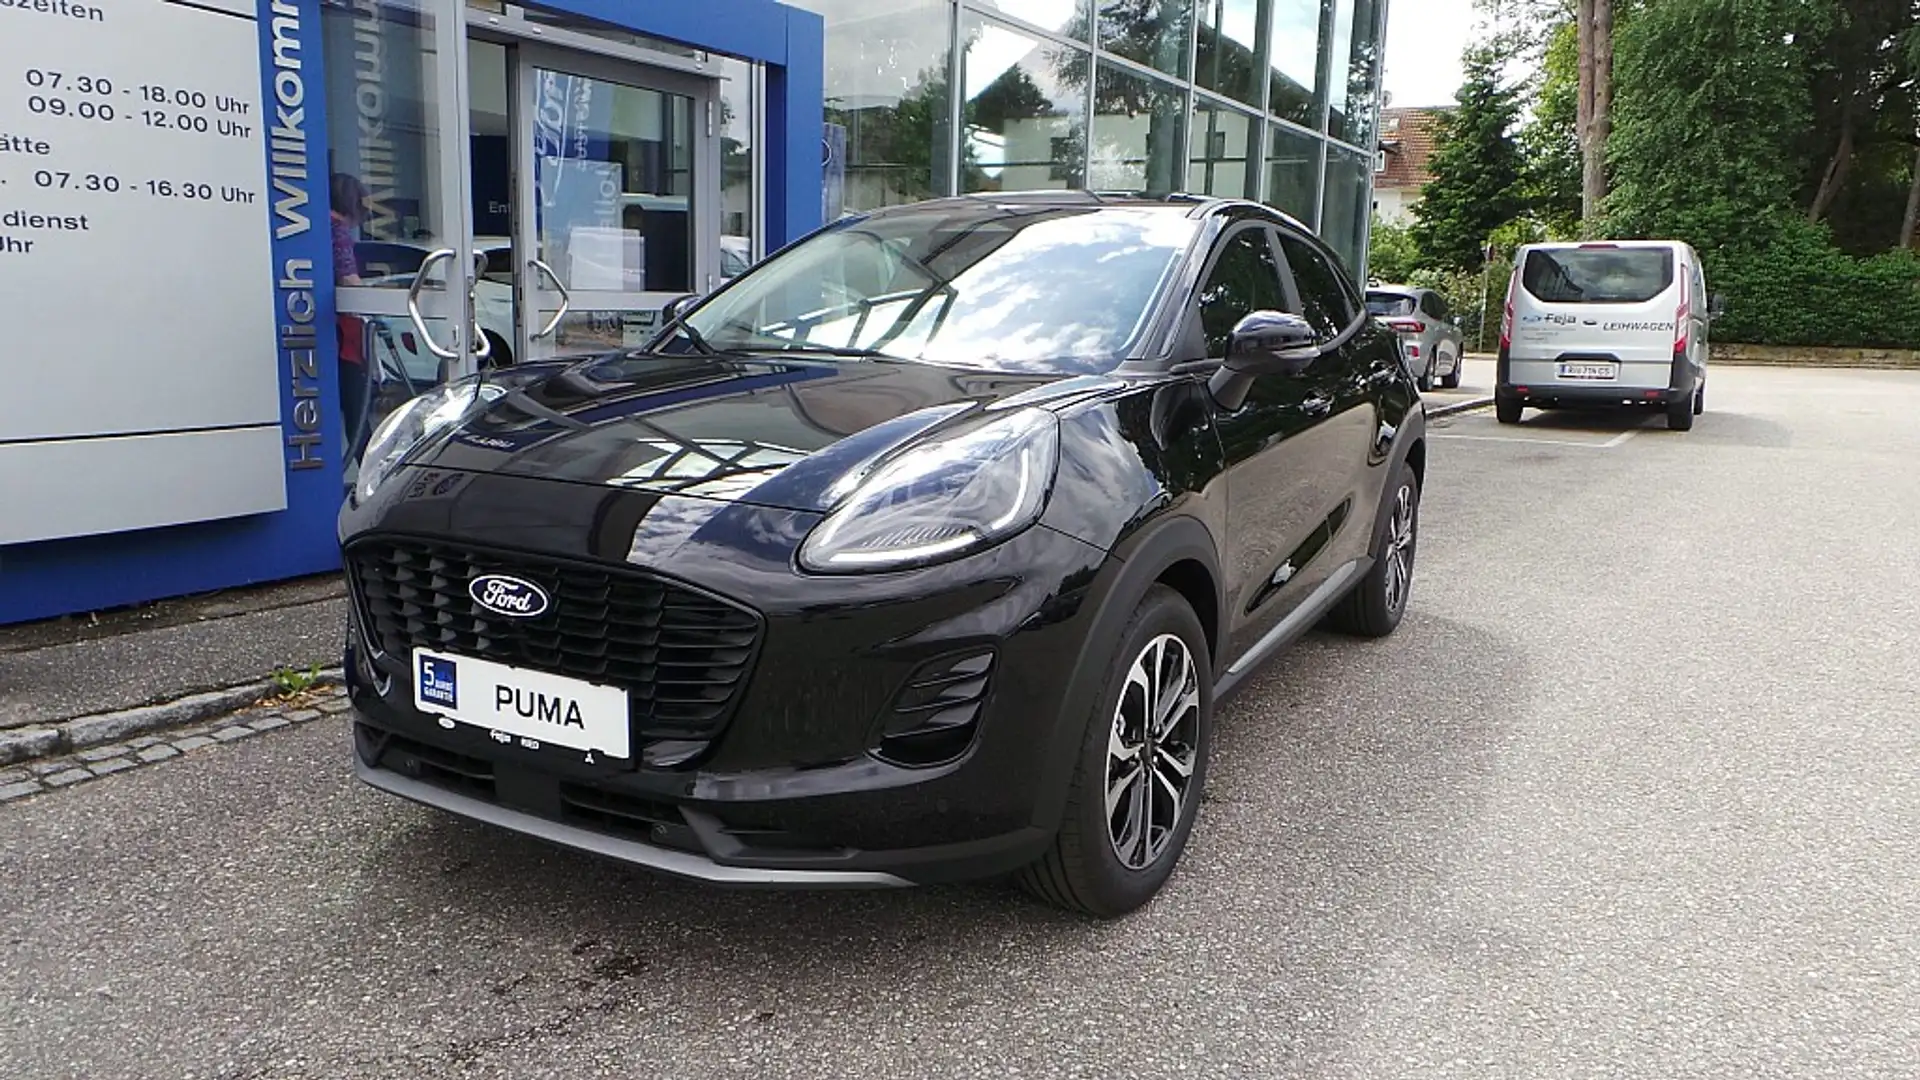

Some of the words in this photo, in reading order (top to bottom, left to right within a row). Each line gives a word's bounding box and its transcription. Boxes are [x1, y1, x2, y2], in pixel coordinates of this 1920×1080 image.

[26, 69, 112, 95] 07.30
[139, 85, 207, 109] 18.00
[216, 95, 250, 115] Uhr
[28, 96, 114, 121] 09.00
[141, 110, 208, 133] 12.00
[217, 119, 251, 138] Uhr
[35, 170, 120, 193] 07.30
[147, 180, 213, 200] 16.30
[221, 186, 255, 204] Uhr
[3, 210, 89, 230] dienst
[1544, 312, 1577, 326] Feja
[1603, 321, 1674, 332] LEIHWAGEN
[279, 258, 324, 470] Herzlich
[482, 580, 532, 612] Ford
[423, 661, 435, 687] 5
[495, 684, 586, 730] PUMA
